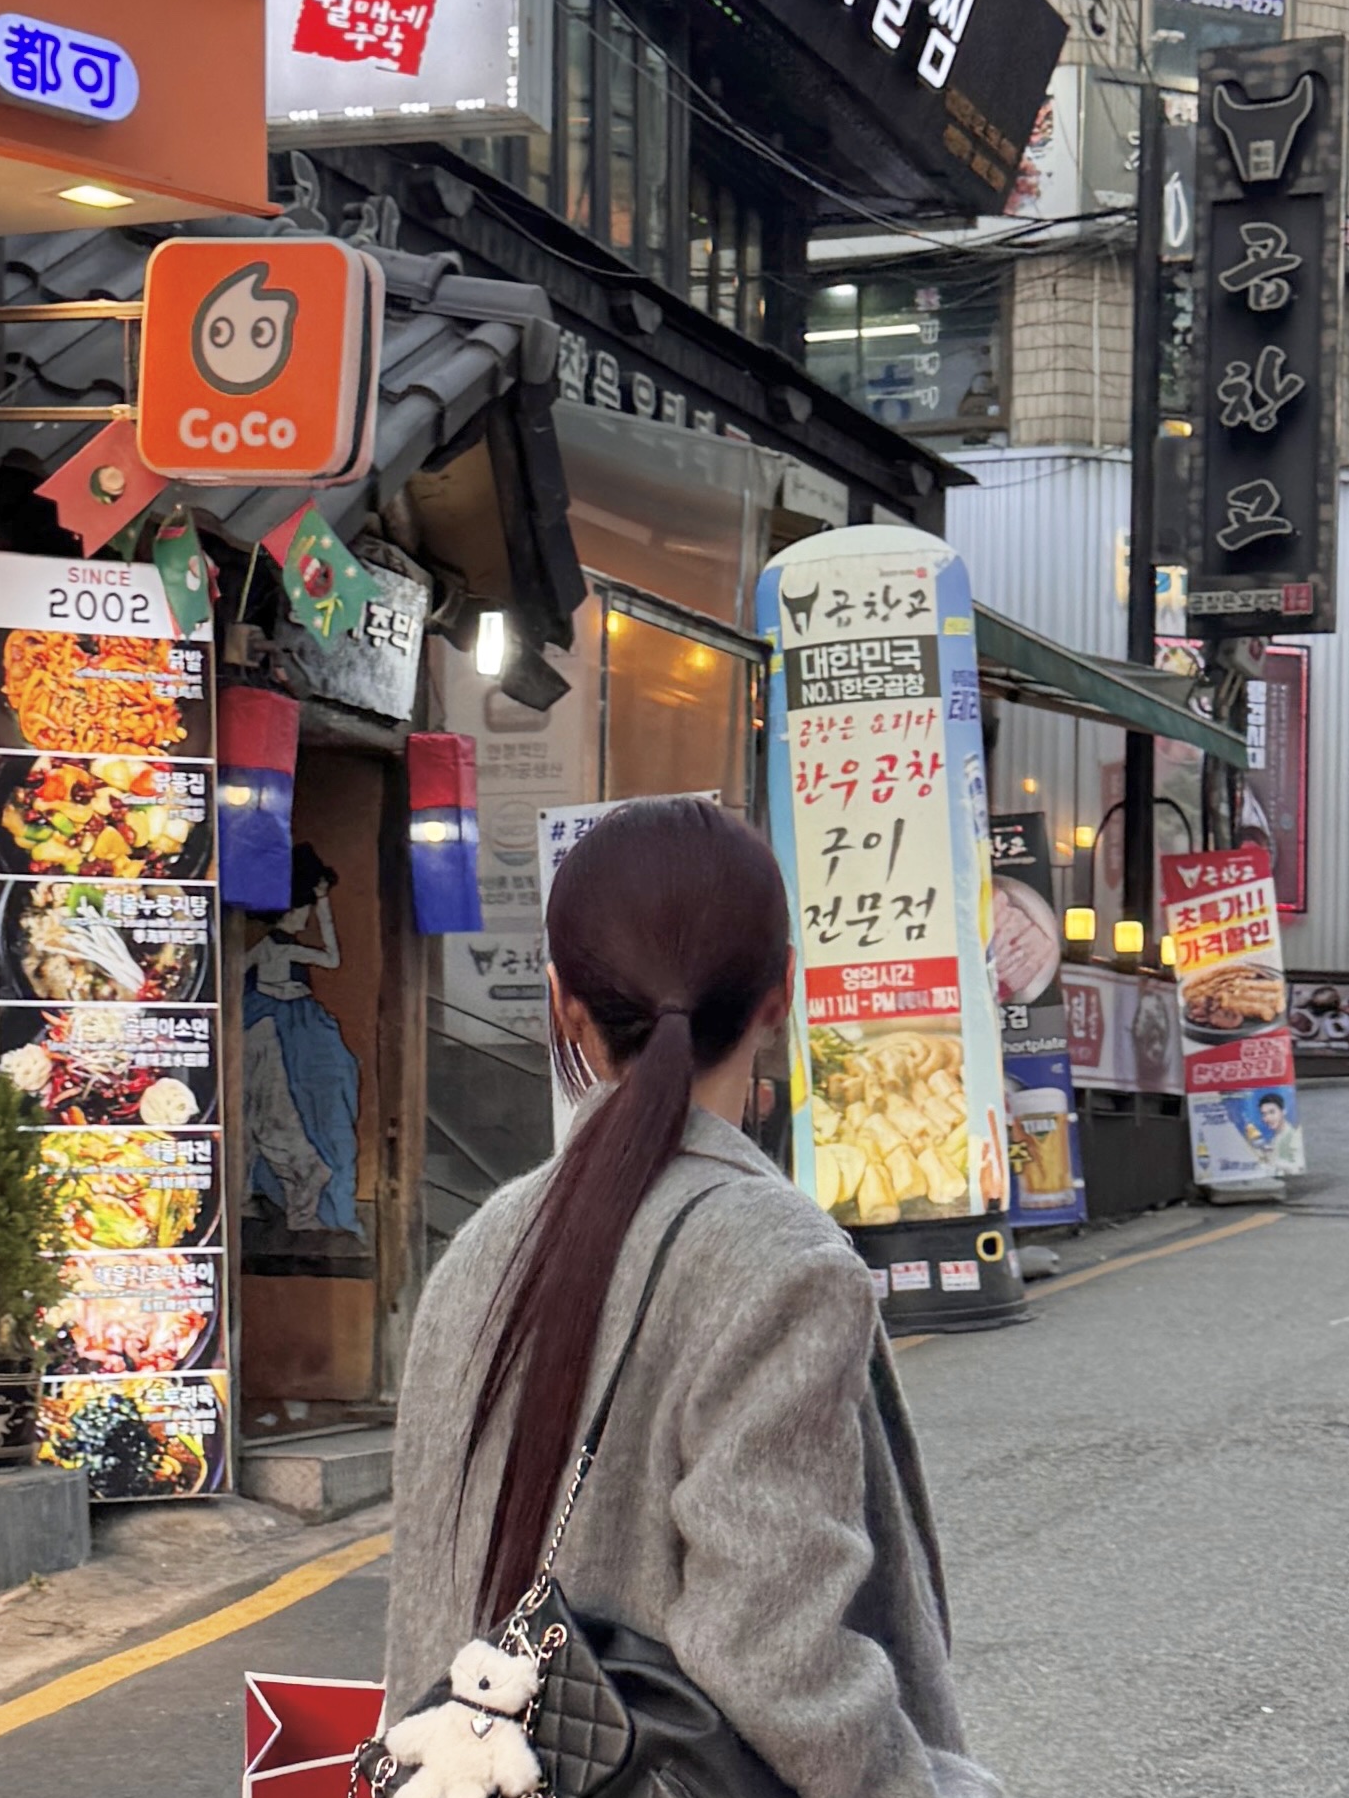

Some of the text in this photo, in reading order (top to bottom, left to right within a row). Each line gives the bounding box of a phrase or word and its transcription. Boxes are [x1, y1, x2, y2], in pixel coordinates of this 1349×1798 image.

[343, 21, 405, 56] 주막
[2, 24, 122, 109] 都可
[180, 408, 296, 453] CoCo
[68, 567, 131, 586] SINCE
[49, 588, 150, 624] 2002
[802, 638, 921, 681] 대한민국
[821, 817, 905, 887] 구이
[804, 887, 936, 947] 전문점
[1180, 919, 1271, 968] 가격할인
[841, 963, 915, 991] 영업시간
[1003, 1037, 1066, 1053] hortplate
